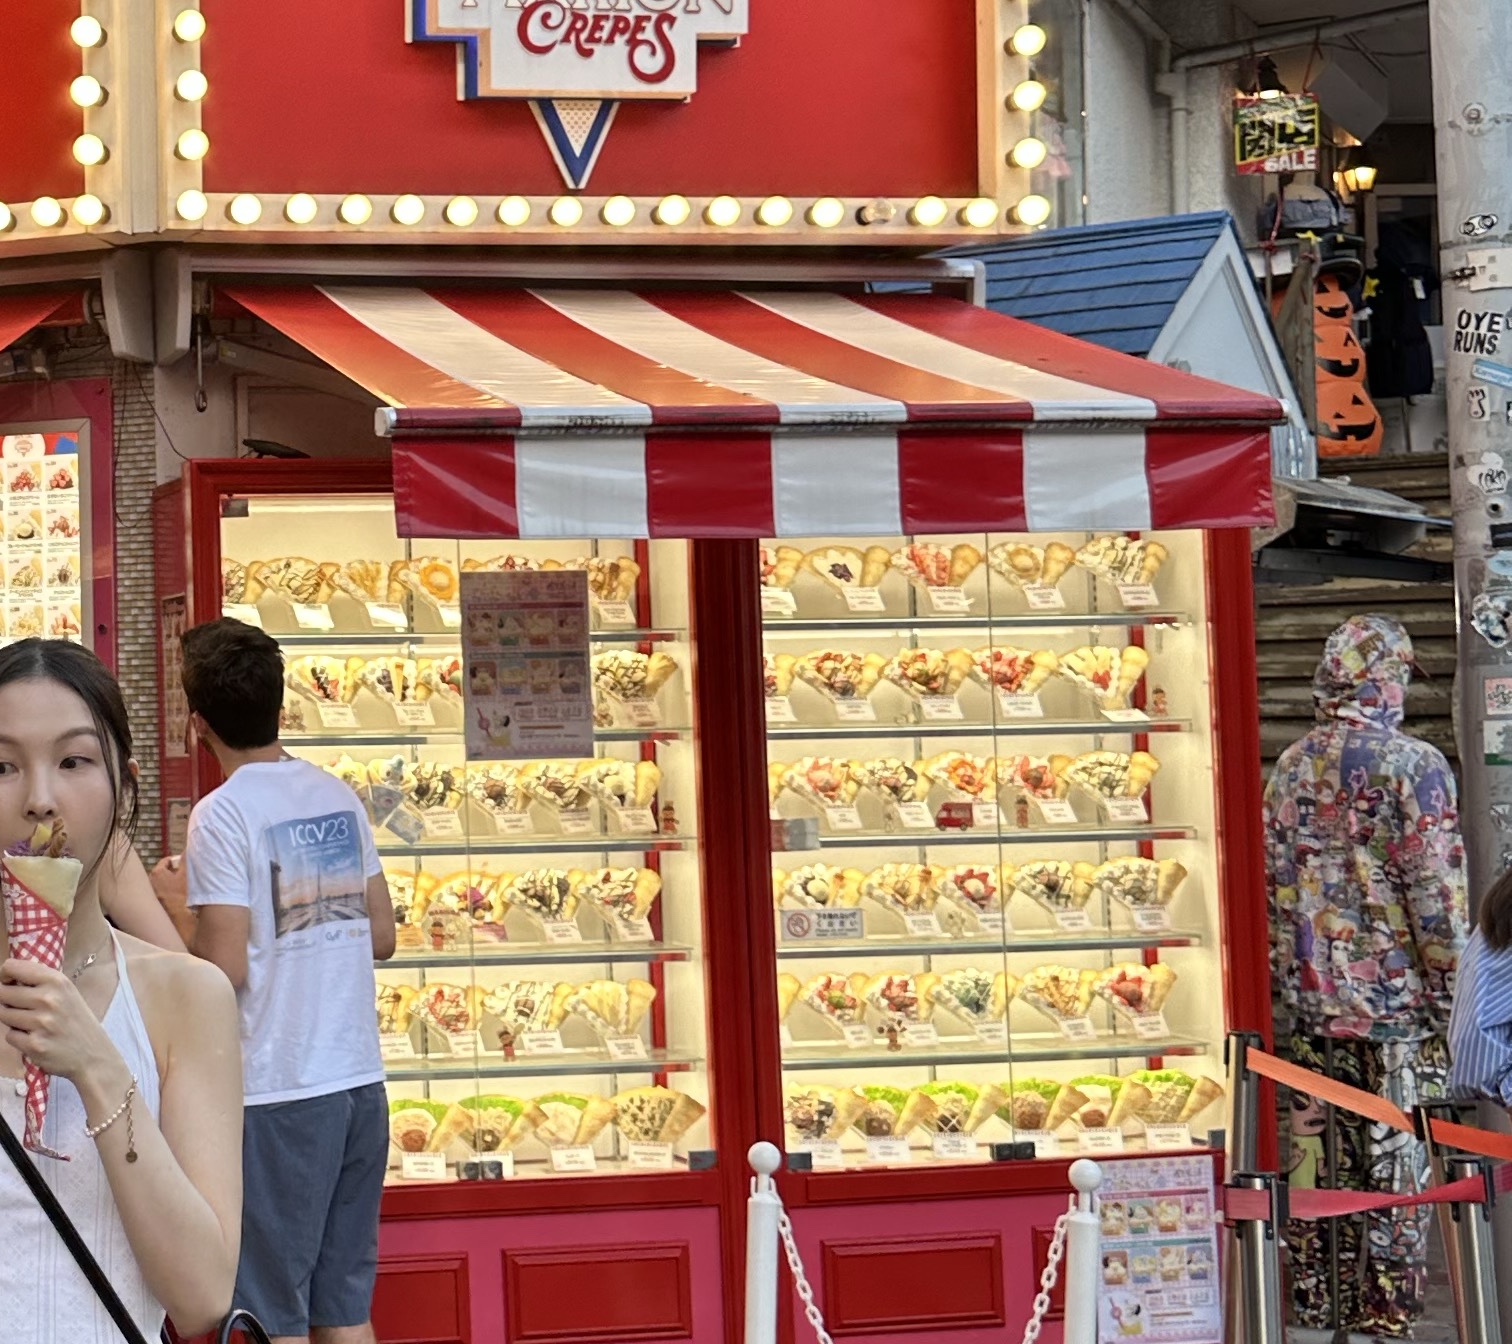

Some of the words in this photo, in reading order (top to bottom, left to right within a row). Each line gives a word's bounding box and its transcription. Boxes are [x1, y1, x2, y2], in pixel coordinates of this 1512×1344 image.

[517, 0, 678, 83] CREPES
[1264, 148, 1317, 172] SALE
[1457, 309, 1504, 333] OYE
[1453, 330, 1499, 355] RUNS
[289, 817, 348, 847] ICCV23
